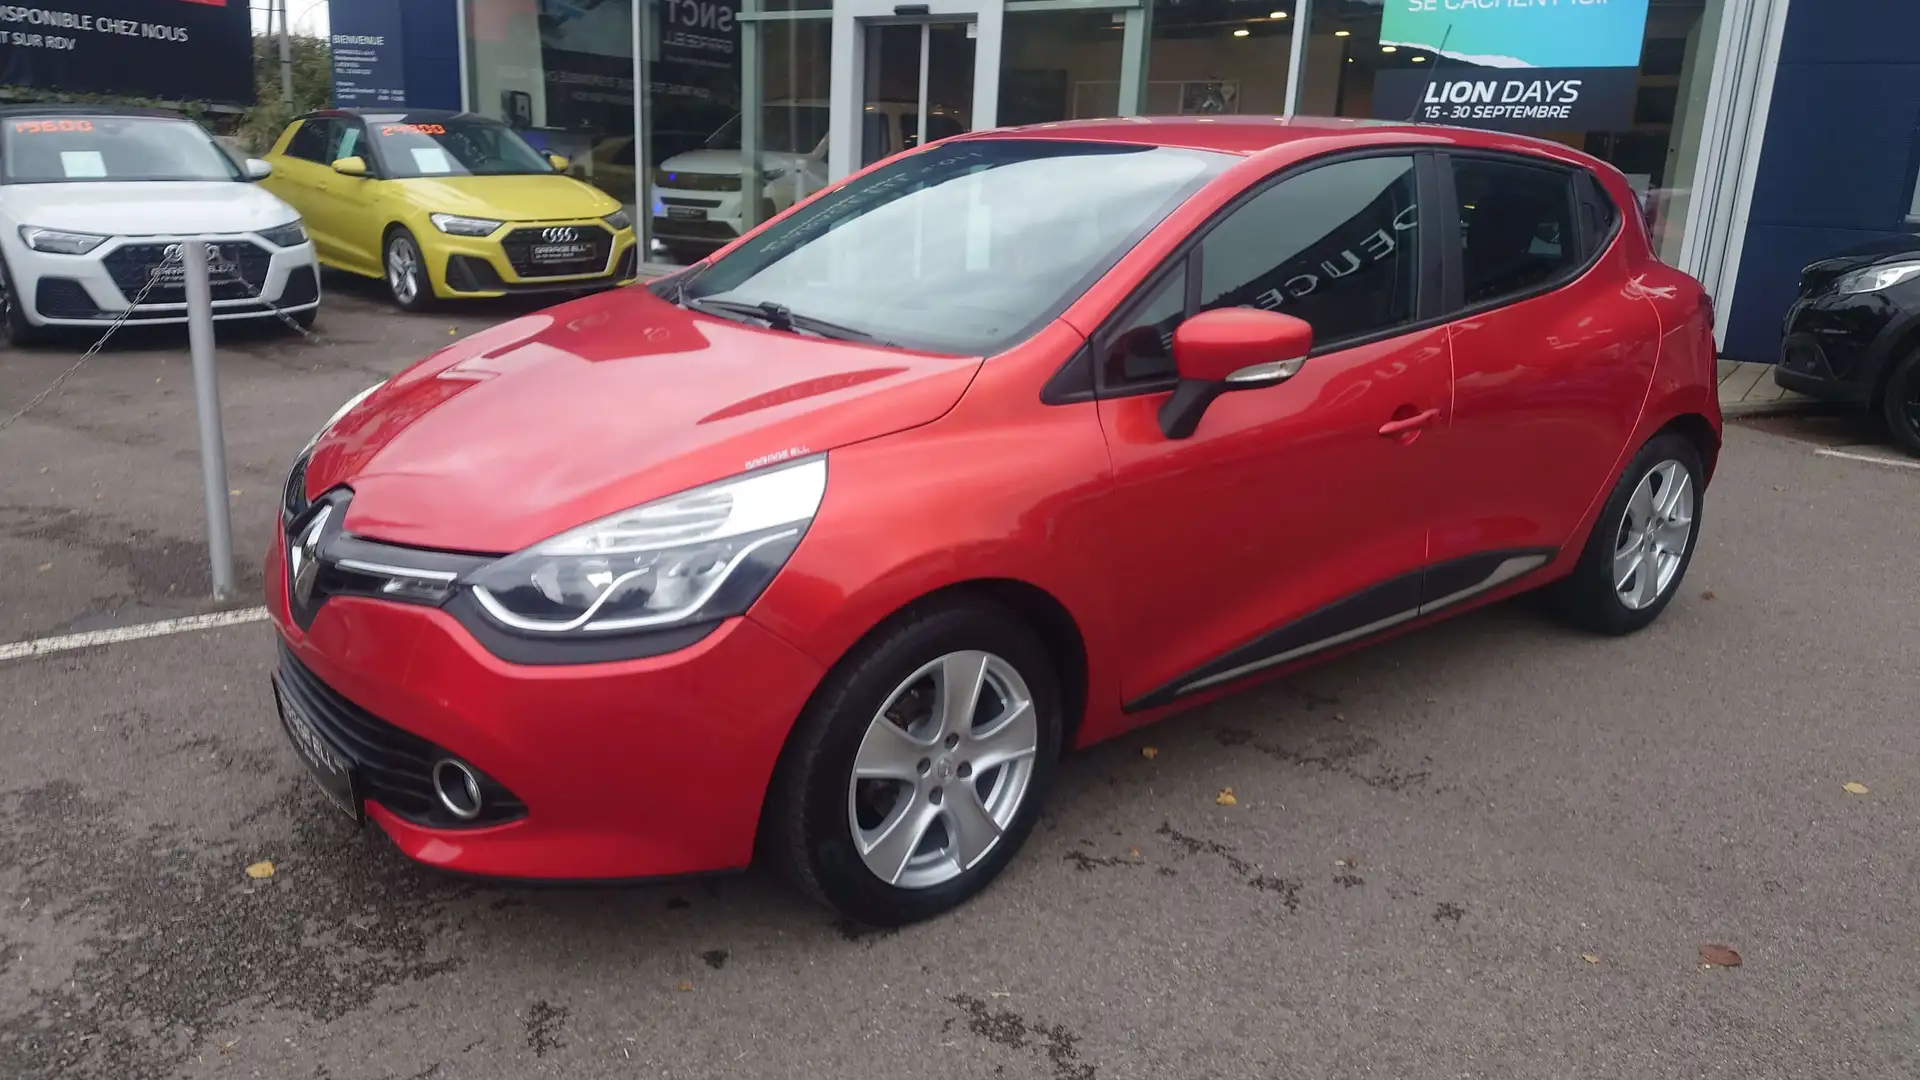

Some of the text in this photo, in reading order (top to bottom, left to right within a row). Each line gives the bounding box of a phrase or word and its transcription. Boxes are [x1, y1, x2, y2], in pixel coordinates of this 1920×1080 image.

[0, 5, 189, 43] ISPONIBLE CHEZ NOUS
[0, 31, 11, 44] T
[12, 32, 43, 48] SUR
[1424, 80, 1582, 103] LION DAYS
[1424, 106, 1441, 118] 15
[1451, 106, 1471, 118] 30
[1472, 105, 1572, 119] SEPTEMBRE
